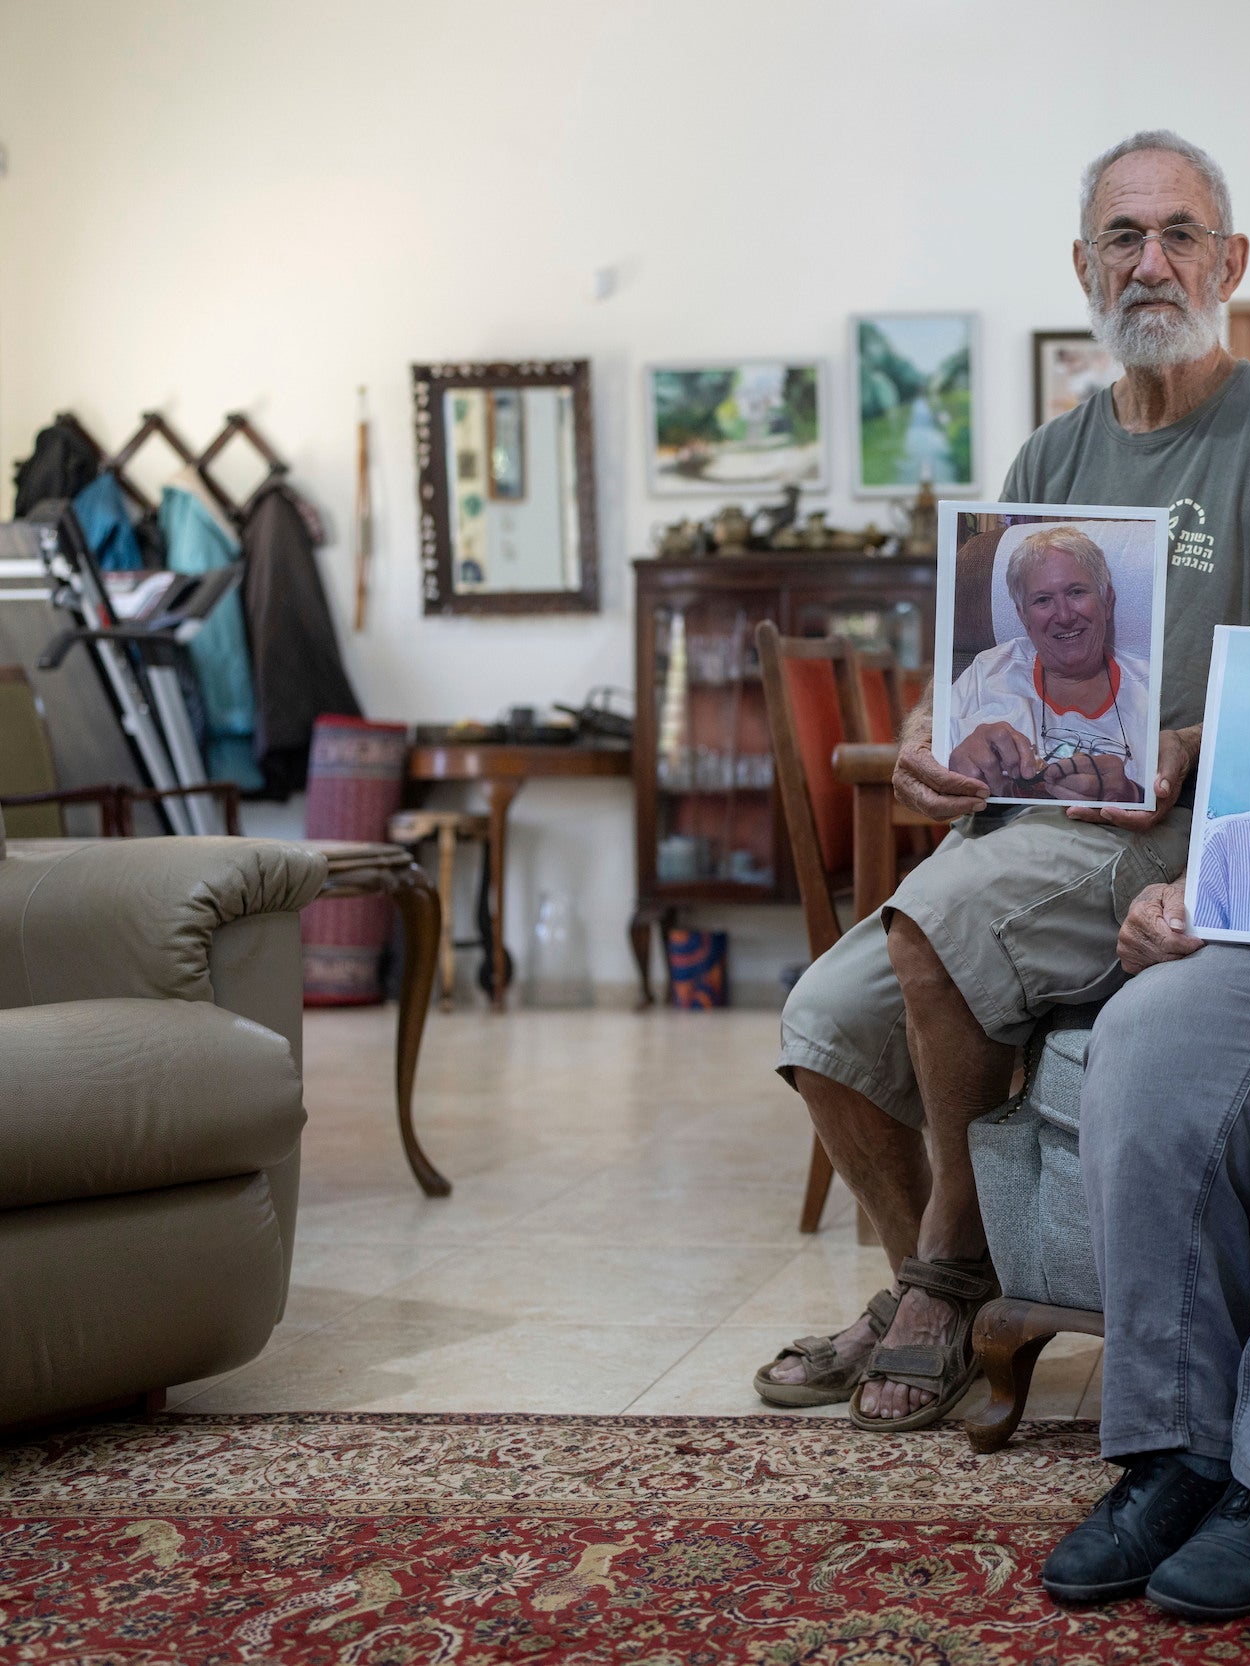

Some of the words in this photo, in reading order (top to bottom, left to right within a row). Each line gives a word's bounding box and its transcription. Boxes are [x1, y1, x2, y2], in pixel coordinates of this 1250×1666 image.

[1179, 530, 1214, 546] רשות
[1175, 543, 1213, 559] הטבע
[1171, 555, 1214, 573] והגנים
